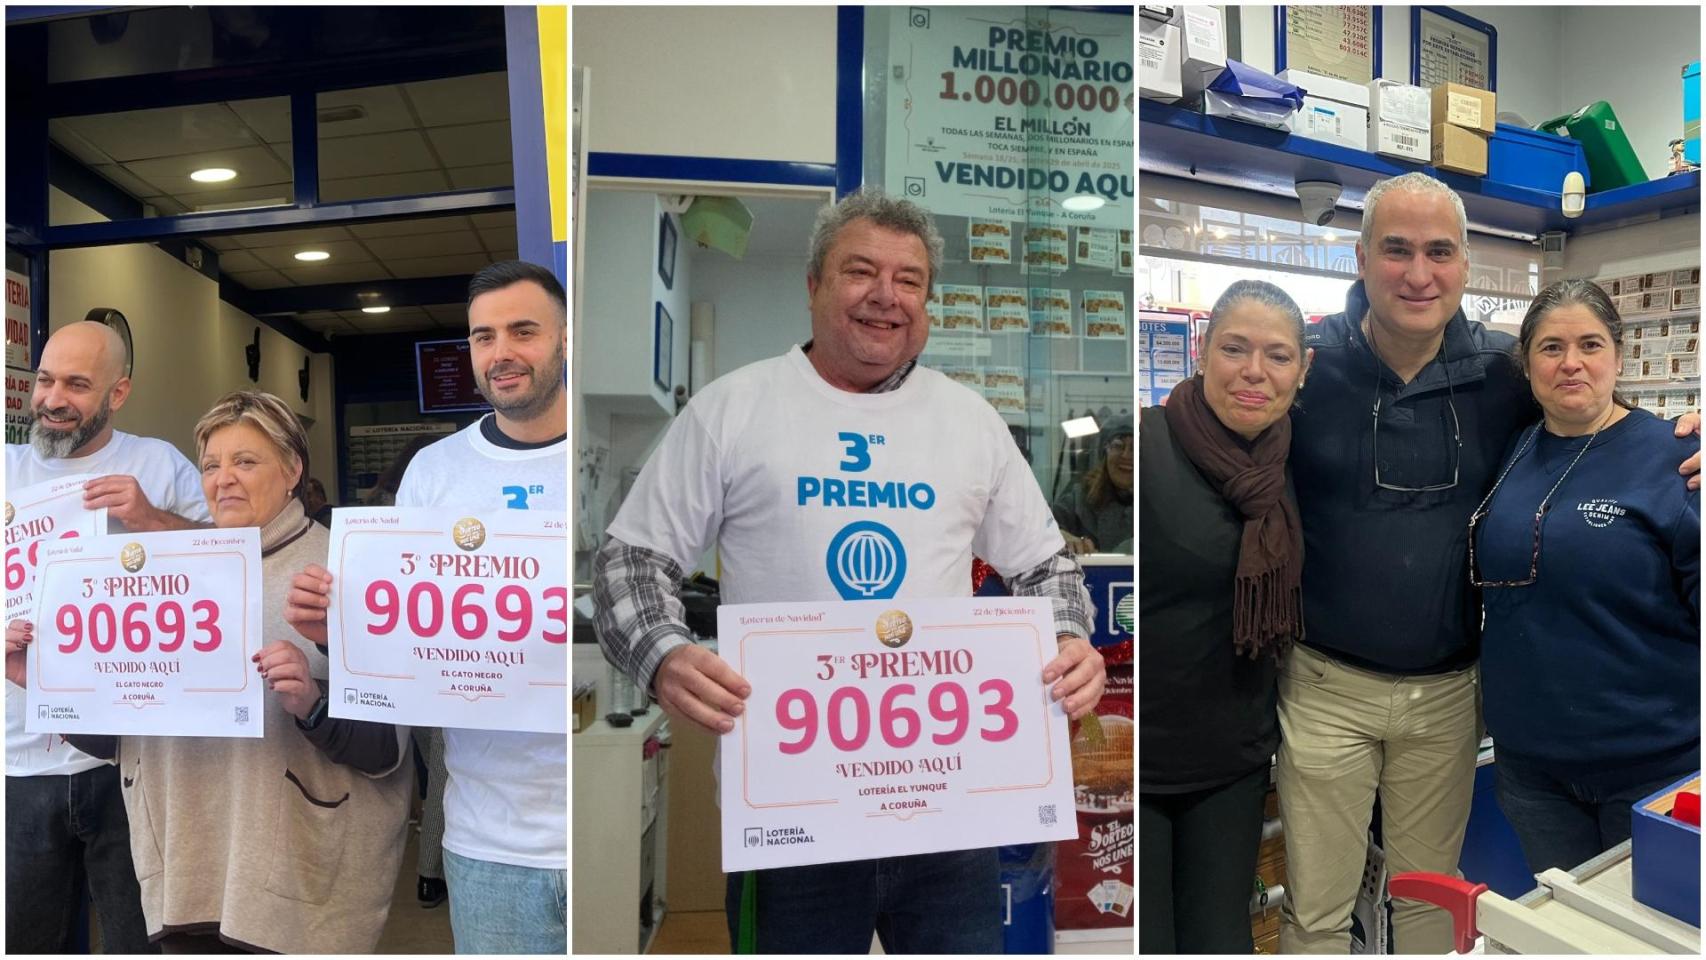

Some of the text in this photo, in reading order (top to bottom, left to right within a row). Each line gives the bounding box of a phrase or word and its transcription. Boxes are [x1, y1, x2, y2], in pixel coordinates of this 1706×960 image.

[989, 26, 1099, 59] PREMIO
[953, 46, 1133, 83] MILLONARIO
[939, 71, 1120, 113] 1.000.000
[994, 116, 1016, 132] EL
[942, 127, 969, 136] TODAS
[970, 129, 984, 137] LAS
[1046, 135, 1099, 146] MILLONARIOS
[988, 142, 1009, 151] TOCA
[1055, 147, 1065, 155] EN
[1067, 147, 1098, 157] ESPAÑA
[935, 160, 1070, 193] VENDIDO
[1017, 207, 1025, 215] El
[1068, 211, 1096, 220] Coruña
[5, 278, 29, 308] TERIA
[18, 379, 30, 393] DE
[797, 476, 936, 510] PREMIO
[1577, 503, 1627, 516] LEE JEANS
[1588, 511, 1610, 520] DENIM
[554, 520, 564, 528] de
[430, 553, 540, 580] PREMIO
[104, 573, 190, 598] PREMIO
[365, 579, 567, 644] 90693
[776, 614, 785, 622] de
[973, 608, 982, 616] 22
[56, 600, 223, 654] 90693
[413, 646, 525, 667] VENDIDO AQUÍ
[851, 648, 973, 679] PREMIO
[94, 658, 181, 676] VENDIDO AQUÍ
[451, 671, 473, 679] GATO
[475, 672, 503, 680] NEGRO
[128, 692, 155, 701] CORUÑA
[360, 690, 388, 701] LOTERÍA
[458, 684, 493, 693] CORUÑA
[51, 706, 74, 714] LOTERÍA
[360, 699, 396, 709] NACIONAL
[775, 678, 1019, 755] 90693
[836, 752, 962, 778] VENDIDO AQUÍ
[858, 784, 896, 796] LOTERÍA
[910, 782, 948, 793] YUNQUE
[889, 799, 928, 810] CORUÑA
[766, 826, 805, 837] LOTERÍA
[1107, 819, 1120, 831] EL
[766, 835, 815, 846] NACIONAL
[1088, 824, 1134, 851] SORTEO
[1112, 844, 1133, 862] UNE
[1093, 853, 1111, 870] NOS
